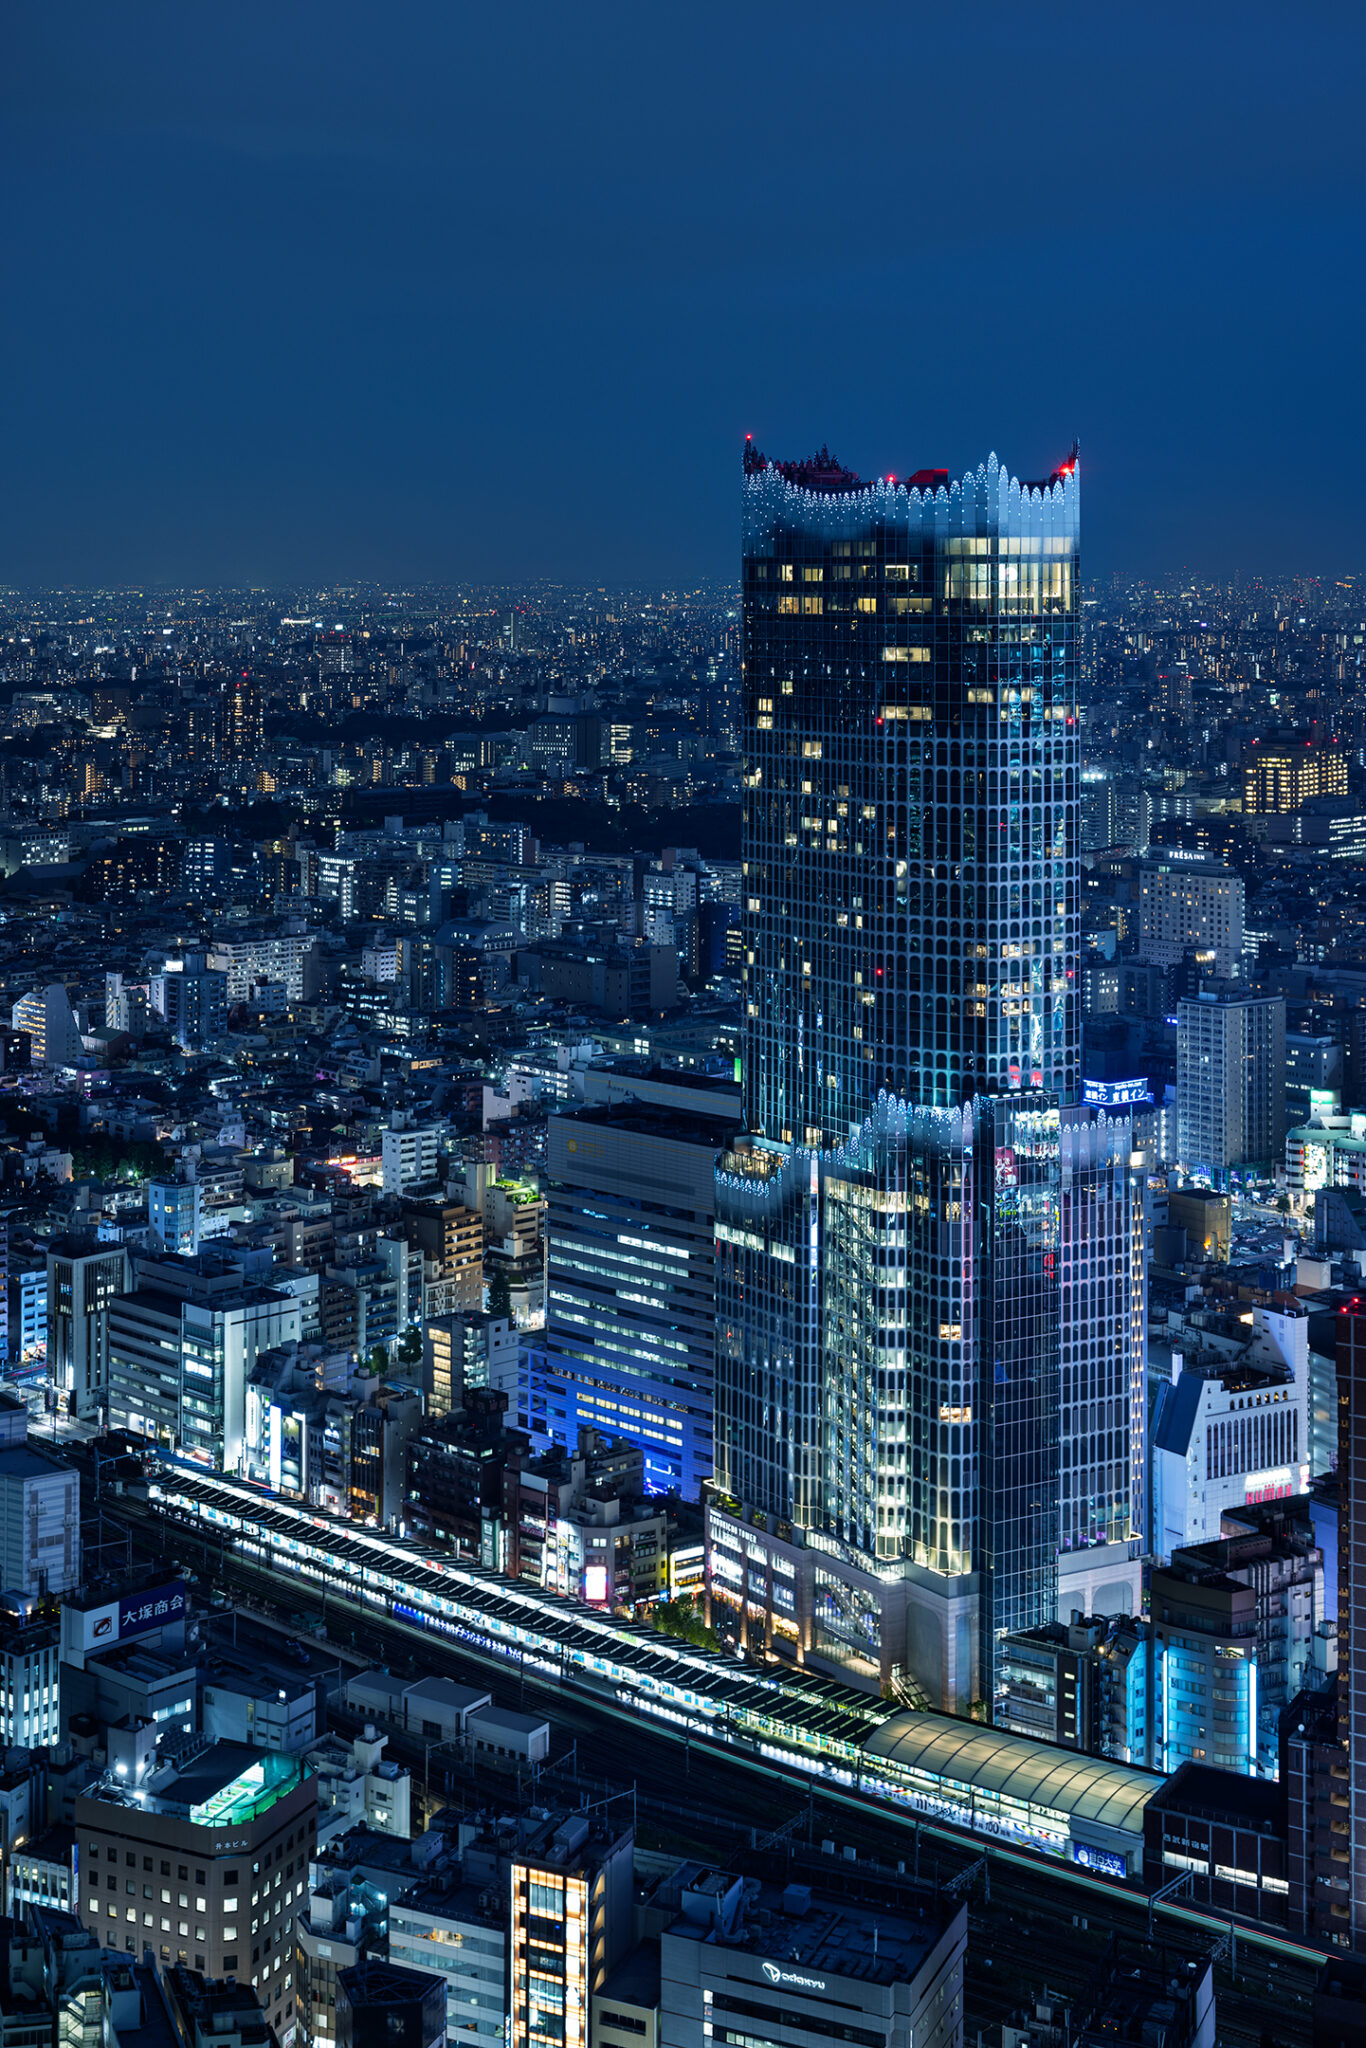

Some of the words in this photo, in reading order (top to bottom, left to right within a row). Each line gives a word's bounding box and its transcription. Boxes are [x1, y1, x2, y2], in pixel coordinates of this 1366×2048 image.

[1246, 1484, 1292, 1505] HUMAX
[122, 1595, 184, 1627] 大塚商会
[1089, 1852, 1122, 1870] 目白大学
[781, 1972, 826, 1990] odakyu
